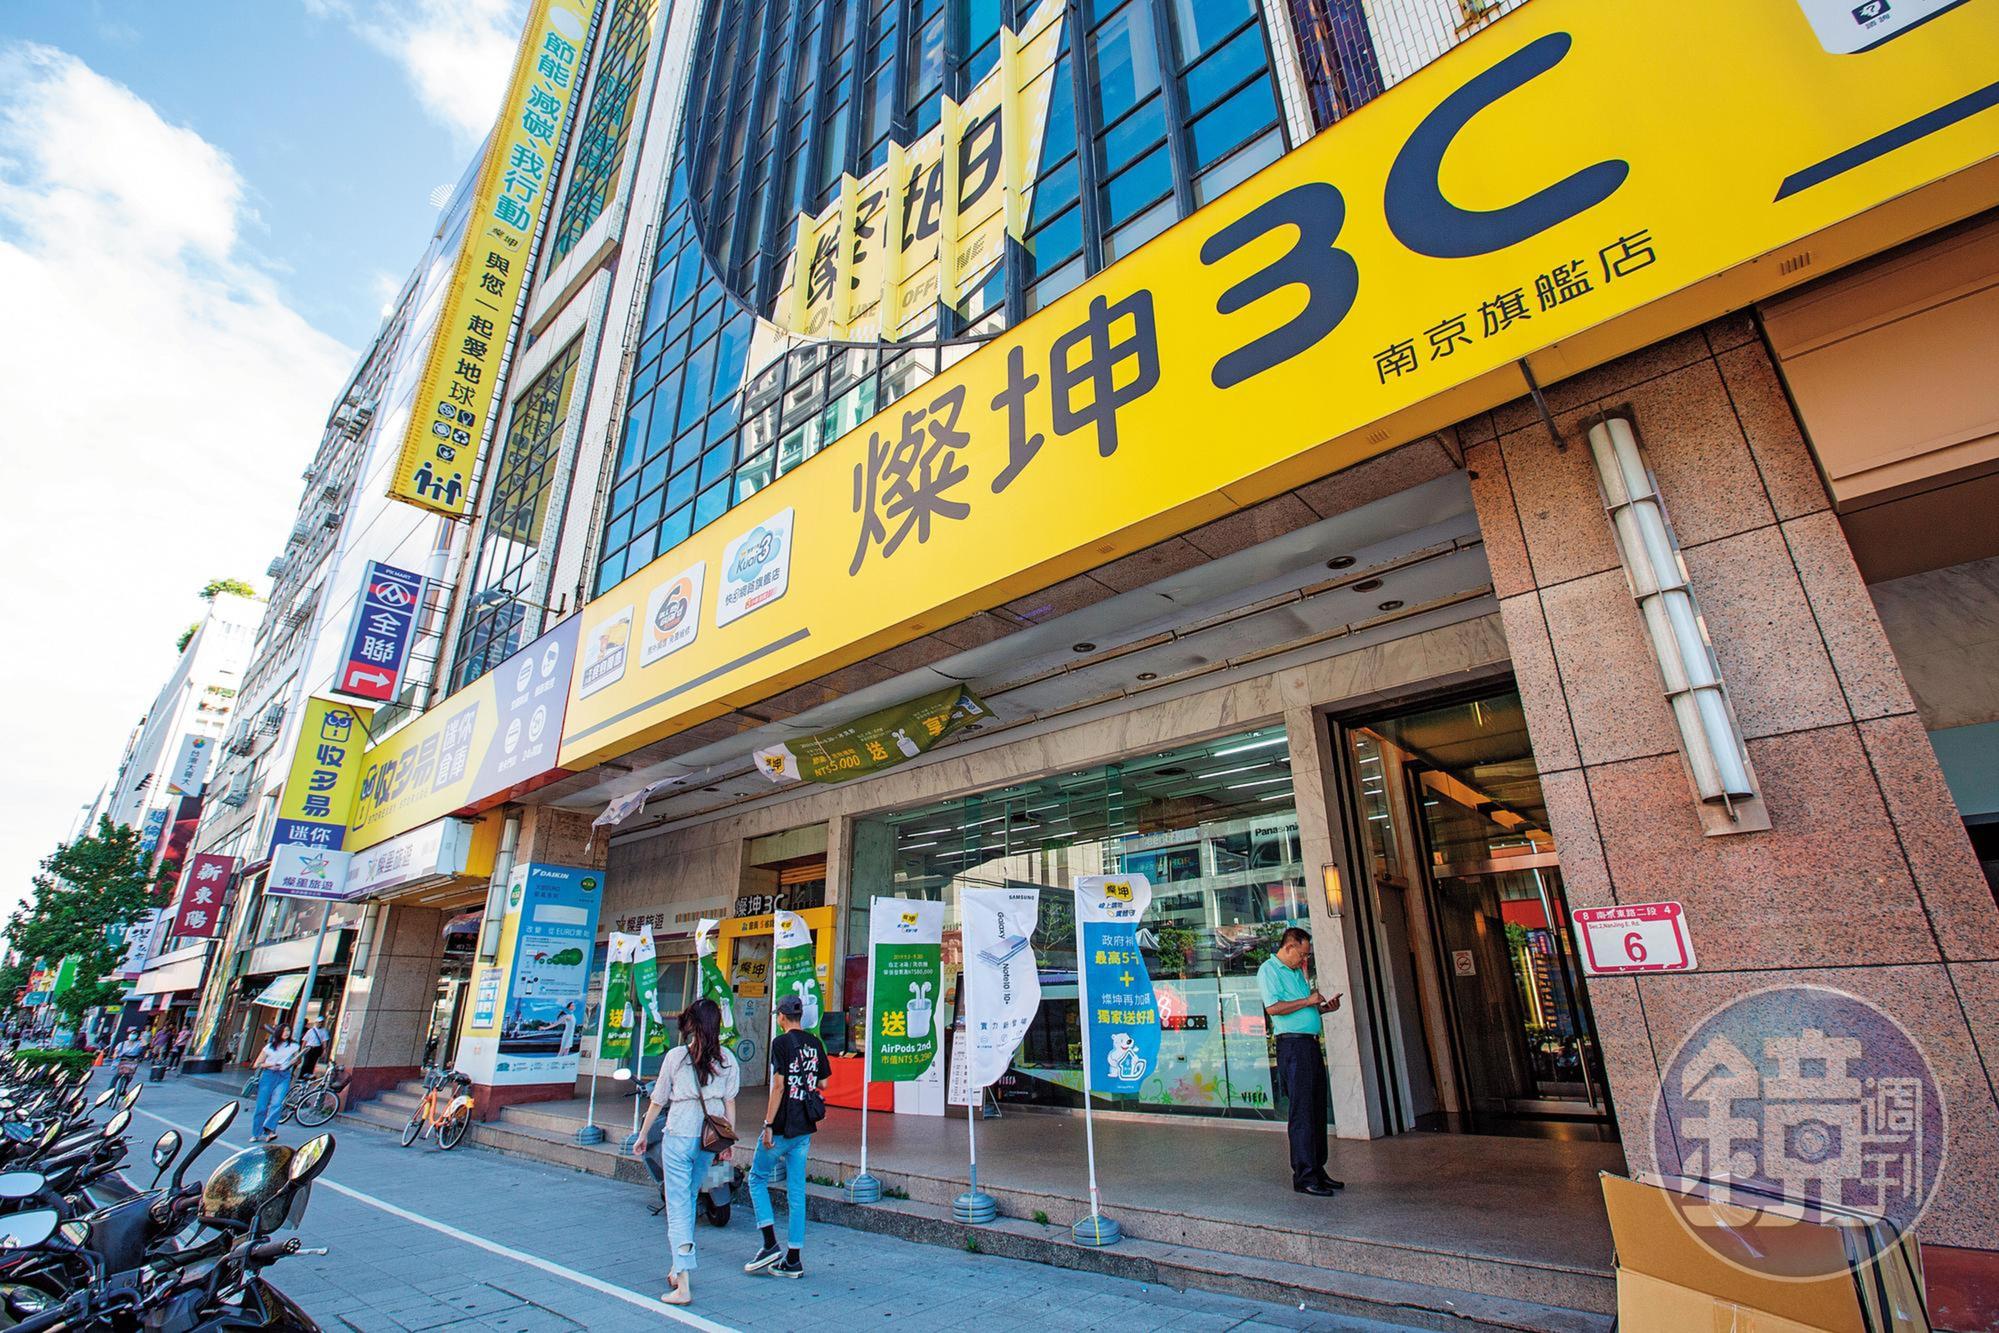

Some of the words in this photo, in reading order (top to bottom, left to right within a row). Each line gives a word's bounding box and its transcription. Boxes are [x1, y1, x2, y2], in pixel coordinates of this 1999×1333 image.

[494, 31, 577, 234] 節能、減碳、我行動
[848, 32, 1630, 577] 燦坤3C
[1373, 228, 1657, 386] 南京旗艦店
[447, 251, 511, 409] 與您一起愛地球
[359, 612, 402, 664] 全聯
[302, 743, 346, 819] 收多易
[288, 824, 333, 843] 迷你
[1255, 821, 1299, 837] Panasoni
[282, 876, 334, 891] 燦星旅遊
[540, 870, 569, 880] DAIKIN
[183, 861, 224, 929] 新東陽
[736, 893, 785, 918] 燦坤3C
[997, 911, 1006, 940] Galaxy
[1582, 911, 1590, 920] 8
[1596, 906, 1658, 920] 南京東路二段
[1663, 904, 1672, 914] 4
[1624, 931, 1648, 963] 6
[881, 1011, 906, 1037] 送
[881, 1043, 916, 1053] AirPods
[916, 1040, 932, 1052] 2nd
